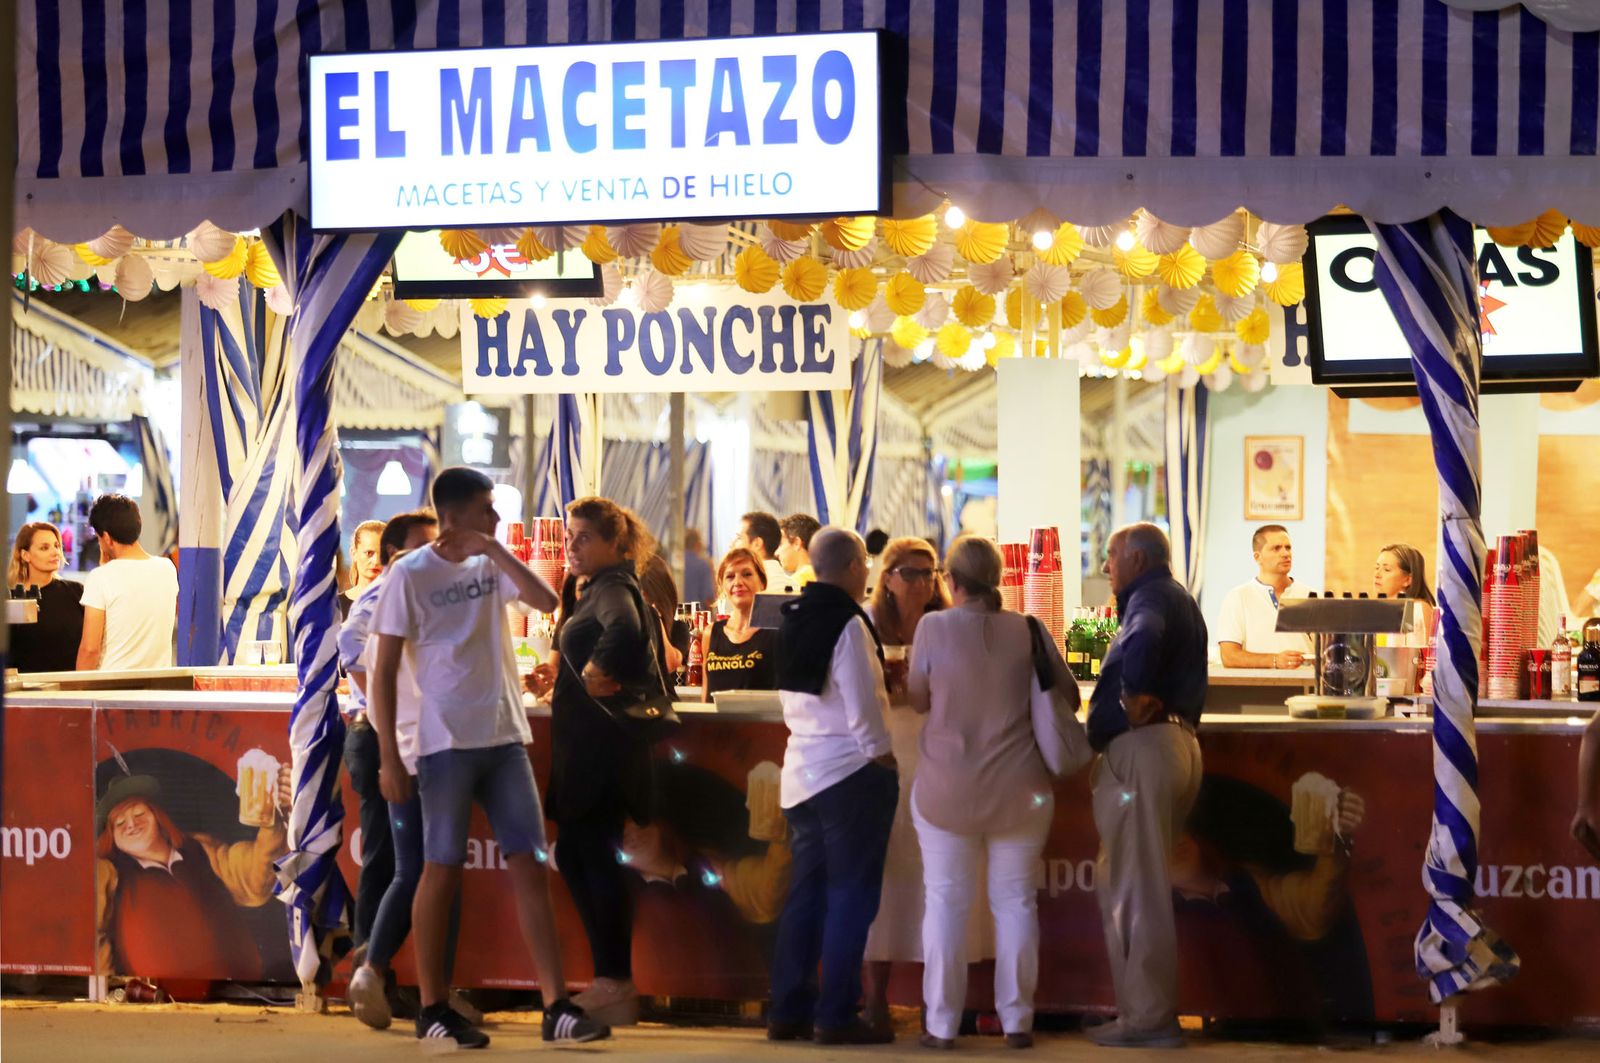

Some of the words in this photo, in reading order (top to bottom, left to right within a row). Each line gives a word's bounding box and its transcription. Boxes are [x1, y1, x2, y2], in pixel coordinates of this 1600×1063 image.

[325, 70, 406, 161] EL
[439, 50, 856, 157] MACETAZO
[396, 181, 523, 207] MACETAS
[535, 180, 550, 202] Y
[561, 177, 649, 202] VENTA
[663, 175, 696, 199] DE
[711, 171, 793, 198] HIELO
[475, 308, 587, 377] HAY
[602, 303, 835, 375] PONCHE
[707, 660, 755, 671] MANOLO
